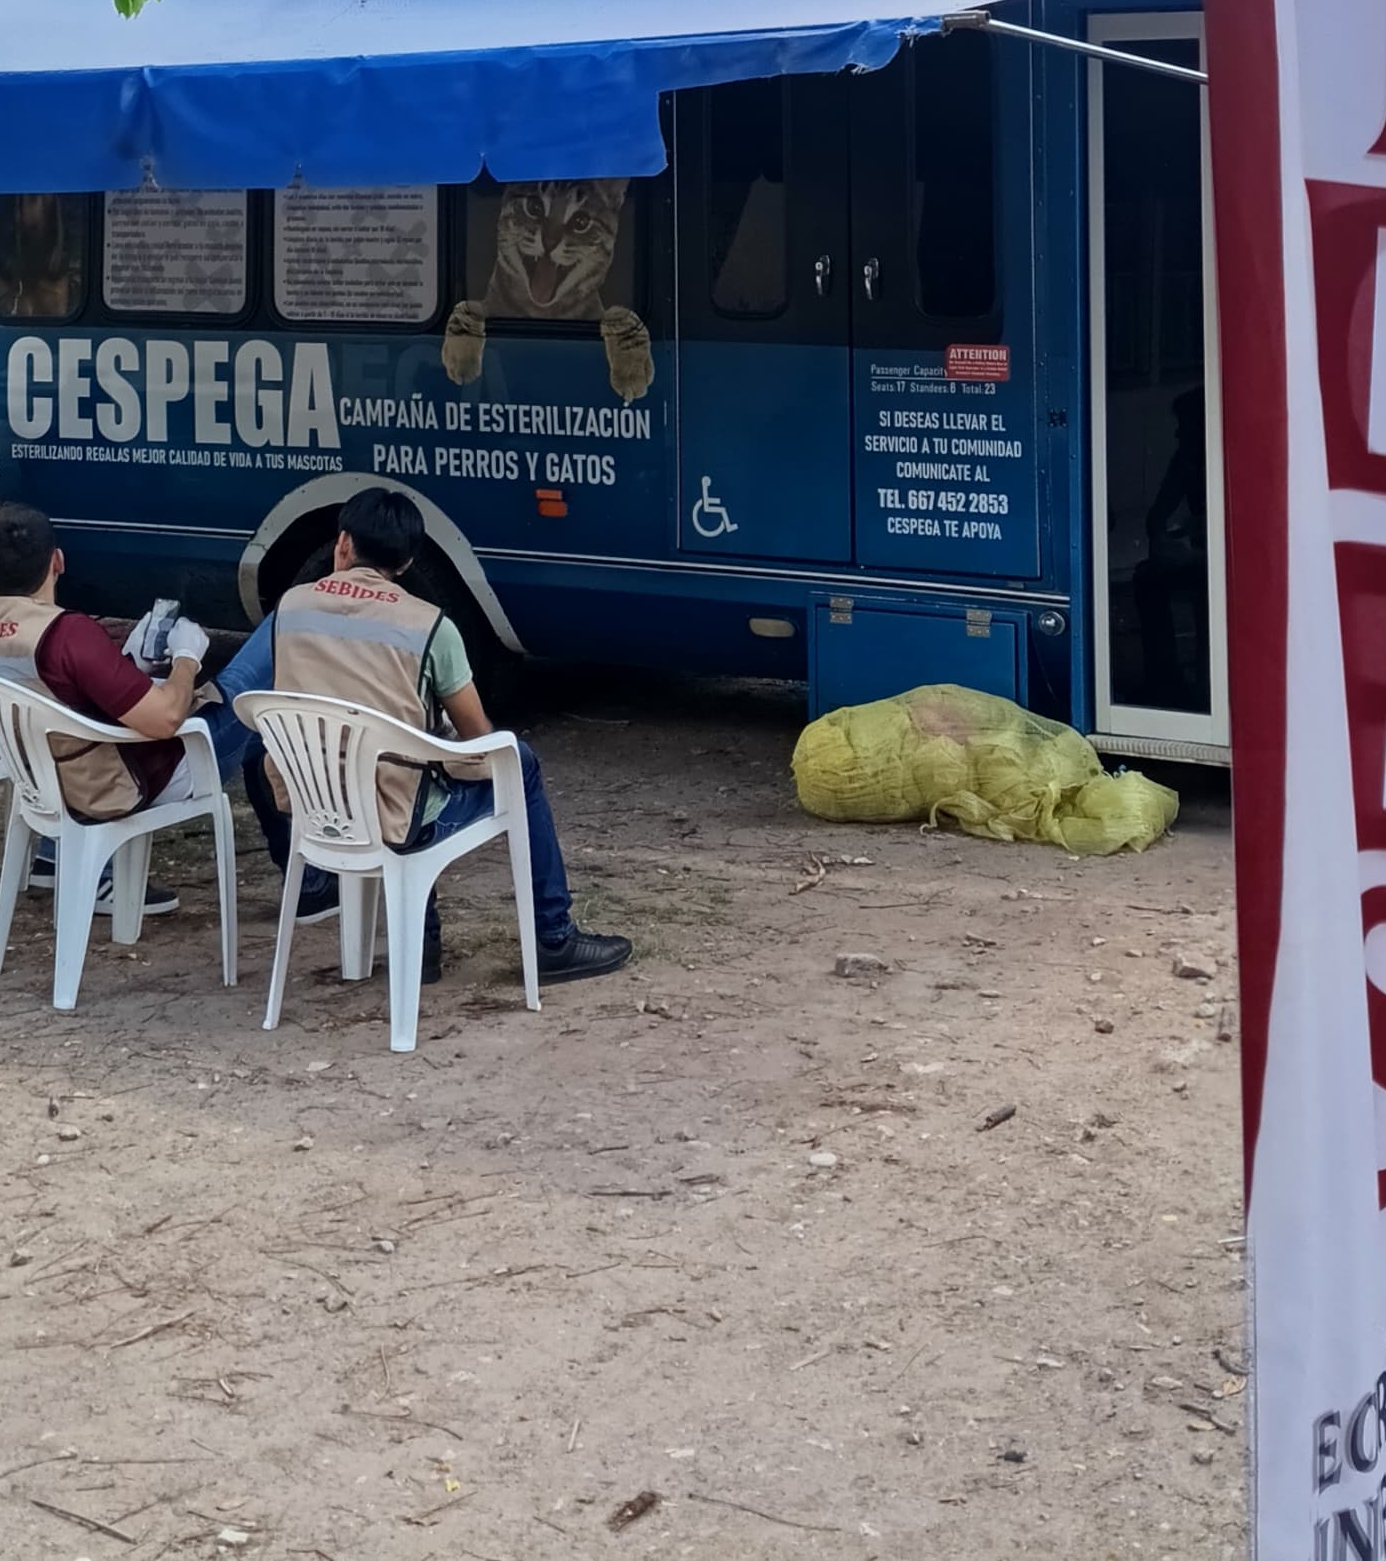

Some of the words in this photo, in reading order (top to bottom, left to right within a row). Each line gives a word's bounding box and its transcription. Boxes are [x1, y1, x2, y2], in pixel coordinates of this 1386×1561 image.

[949, 348, 1007, 361] ATTENTION
[871, 364, 910, 377] Passenger
[7, 336, 341, 449] CESPEGA
[340, 393, 438, 430] CAMPAÑA
[445, 402, 472, 431] DE
[479, 400, 650, 439] ESTERILIZACIÓN
[879, 411, 890, 427] SI
[894, 411, 939, 429] DESEAS
[943, 413, 987, 431] LLEVAR
[991, 414, 1006, 431] EL
[11, 444, 83, 461] ESTERILIZANDO
[86, 446, 129, 463] REGALAS
[132, 447, 166, 464] MEJOR
[169, 449, 210, 466] CALIDAD
[214, 451, 227, 466] DE
[229, 452, 252, 468] VIDA
[255, 453, 263, 468] A
[265, 453, 284, 469] TUS
[288, 454, 343, 471] MASCOTAS
[865, 435, 918, 453] SERVICIO
[921, 437, 930, 454] A
[933, 438, 947, 454] TU
[951, 438, 1022, 458] COMUNIDAD
[373, 444, 428, 475] PARA
[435, 447, 519, 480] PERROS
[525, 451, 539, 481] Y
[545, 452, 616, 486] GATOS
[896, 462, 971, 481] COMUNICATE
[974, 465, 990, 482] AL
[878, 488, 905, 509] TEL.
[908, 490, 935, 510] 667
[937, 491, 966, 512] 452
[969, 493, 1009, 514] 2853
[887, 517, 941, 536] CESPEGA
[944, 520, 959, 537] TE
[962, 521, 1002, 540] APOYA
[314, 580, 400, 603] SEBIDES
